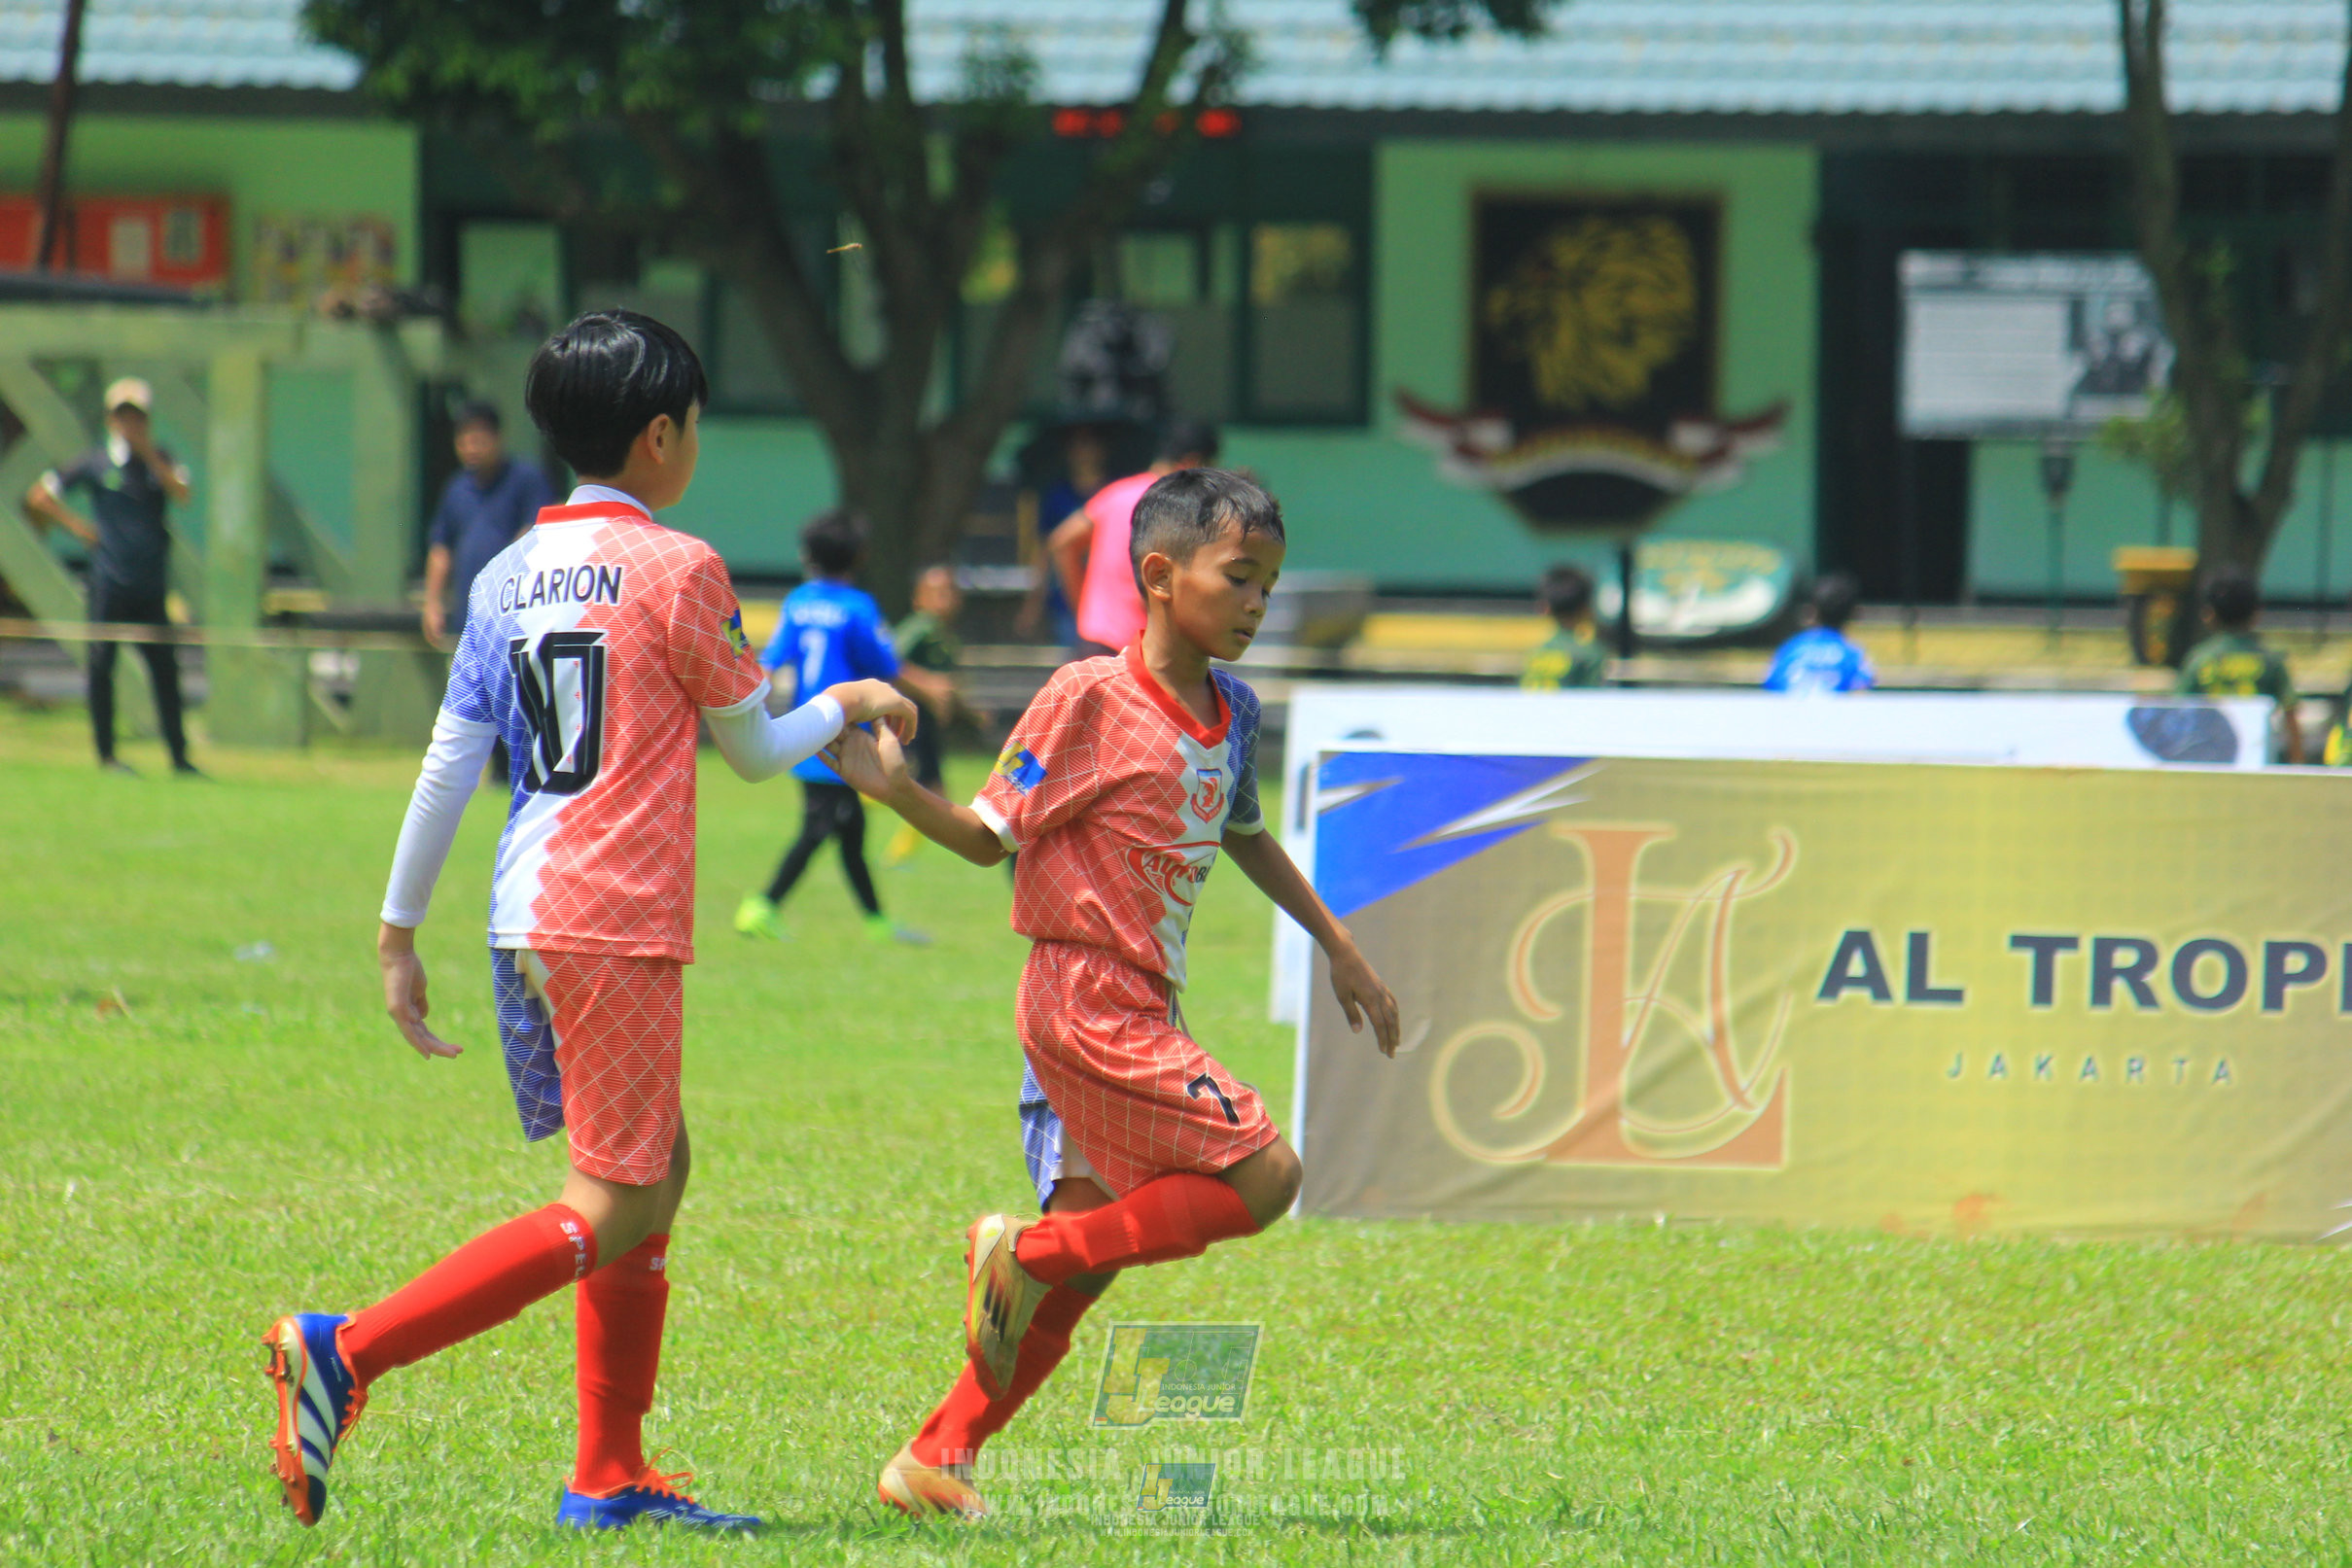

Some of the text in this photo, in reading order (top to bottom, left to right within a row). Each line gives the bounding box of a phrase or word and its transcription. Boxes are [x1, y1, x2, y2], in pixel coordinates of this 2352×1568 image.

[500, 564, 623, 614] CLARION
[1816, 930, 1964, 1002] AL
[1947, 1052, 2231, 1085] JAKARTA
[1186, 1072, 1241, 1127] 7
